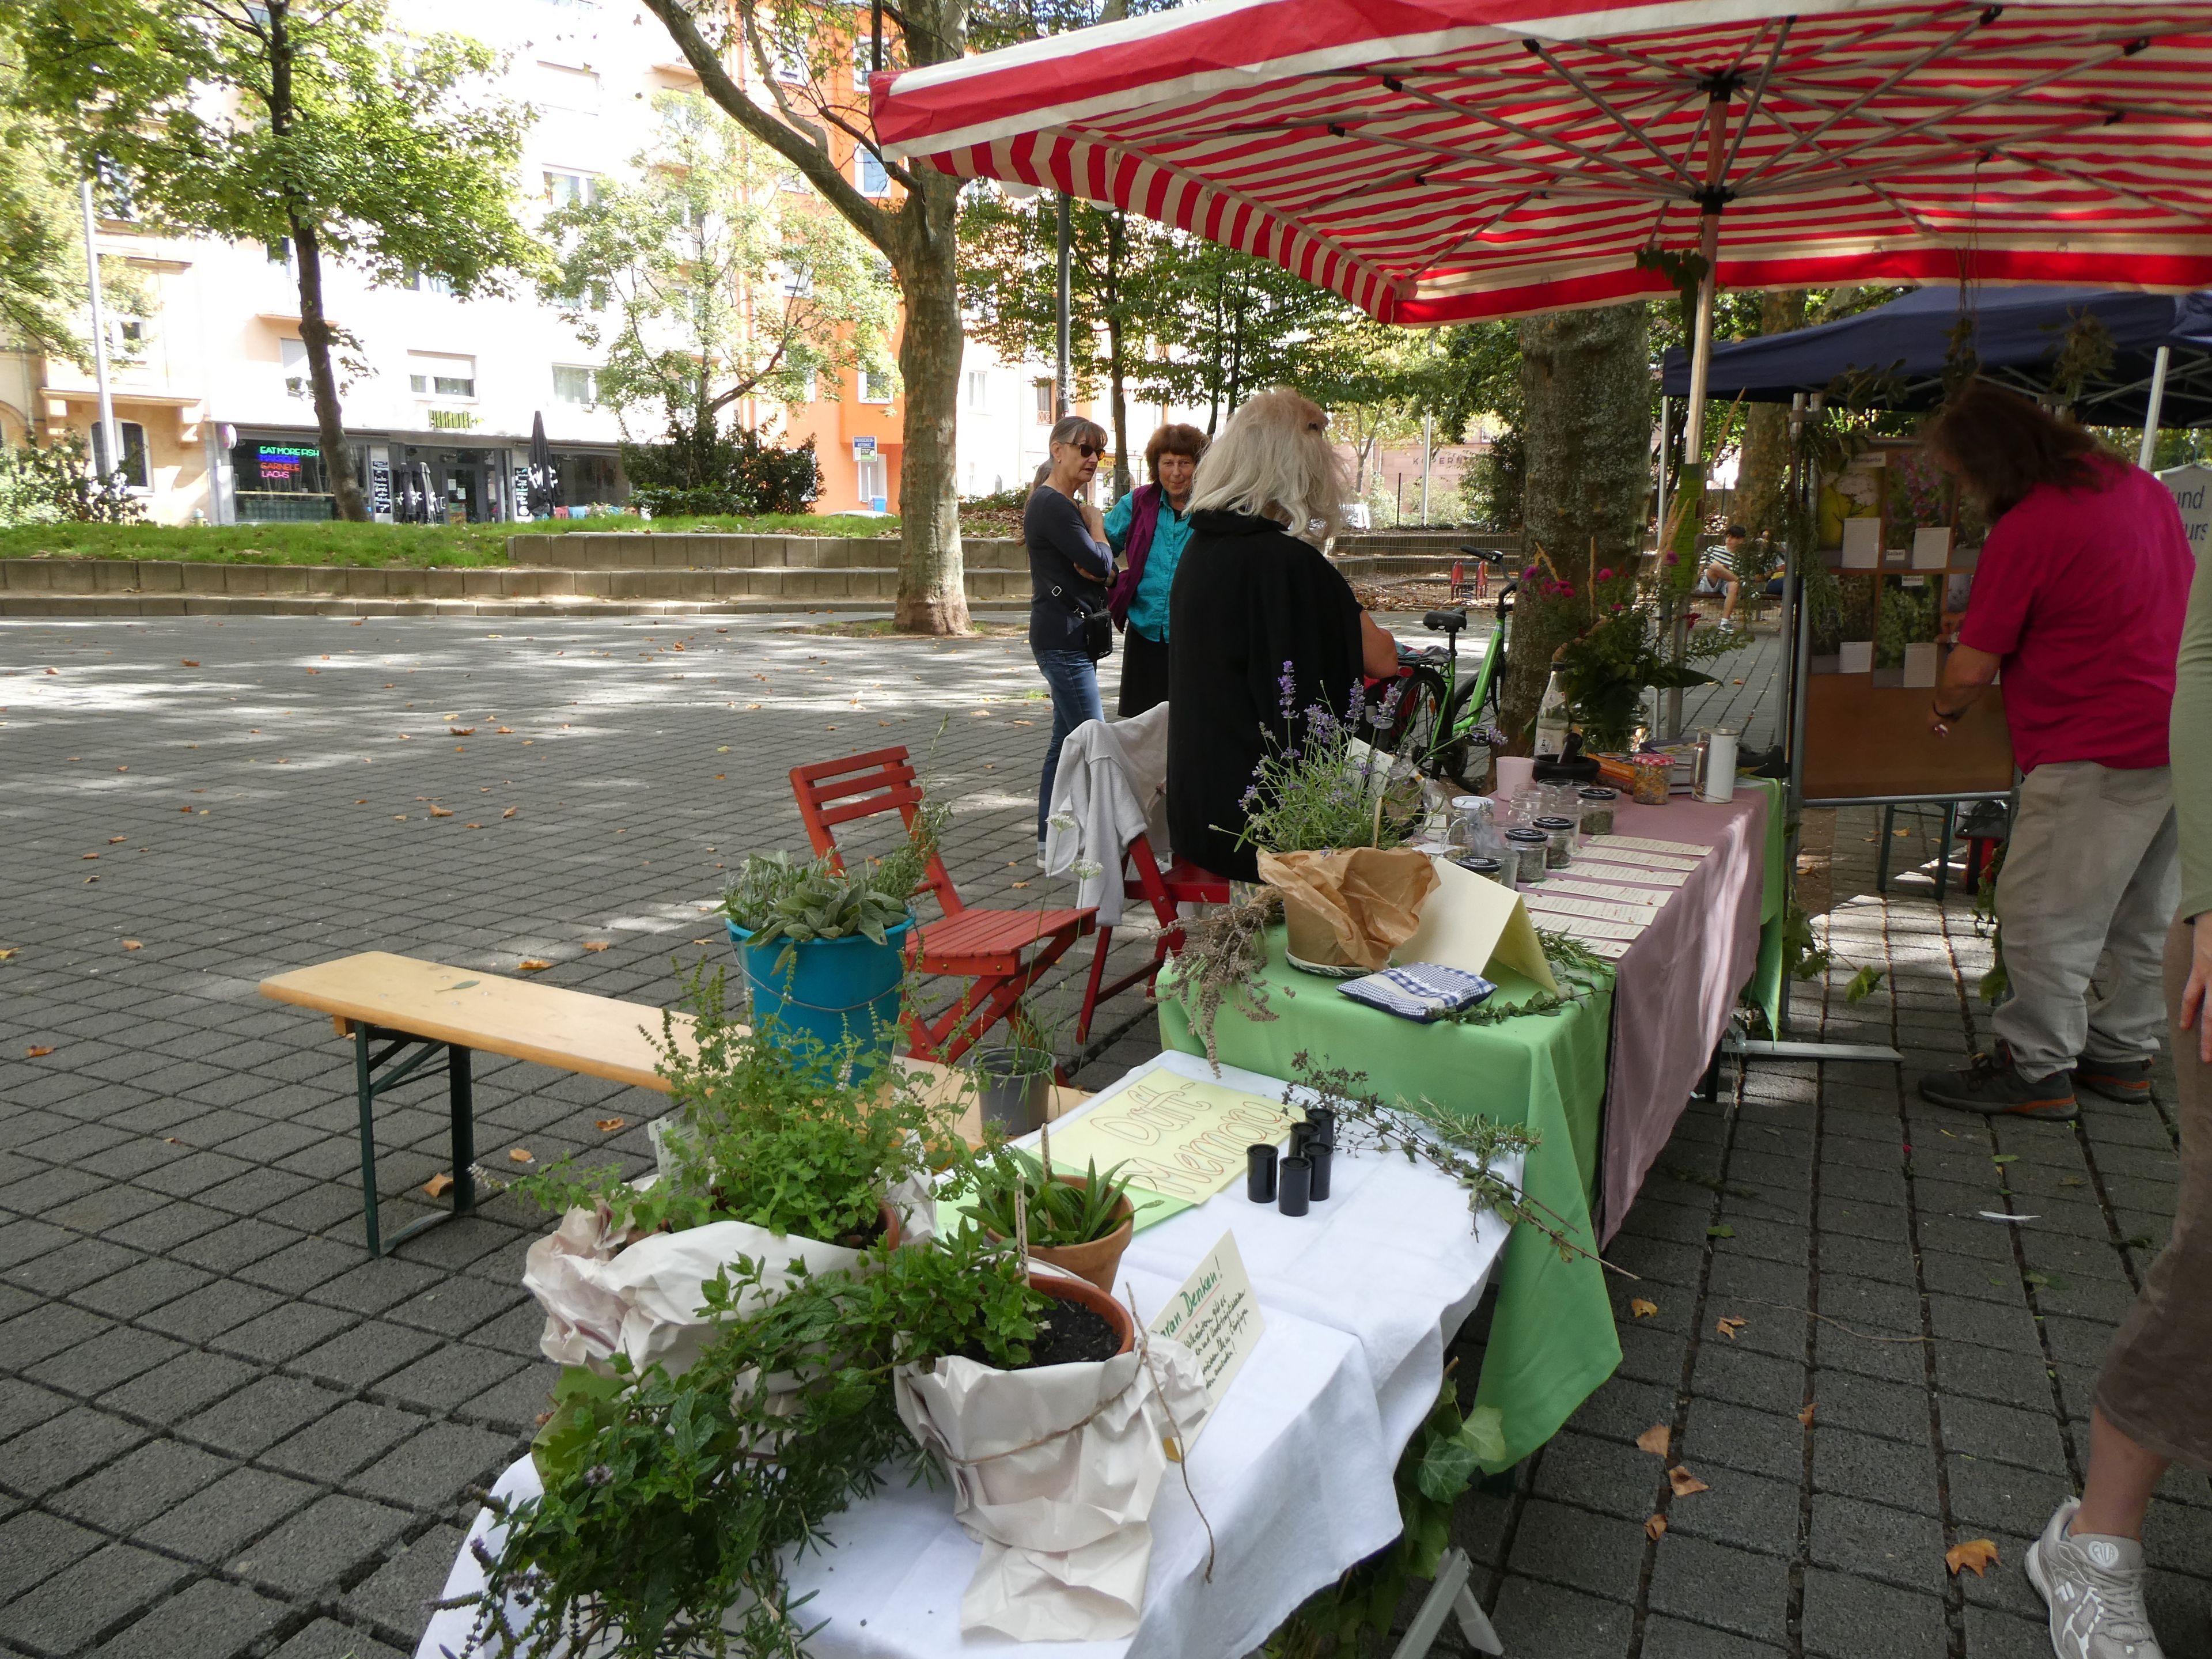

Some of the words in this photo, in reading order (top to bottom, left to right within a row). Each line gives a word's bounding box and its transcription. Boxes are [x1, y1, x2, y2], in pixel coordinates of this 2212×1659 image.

[301, 449, 320, 457] FISH
[262, 471, 289, 479] LACHS
[1152, 1312, 1182, 1337] aran
